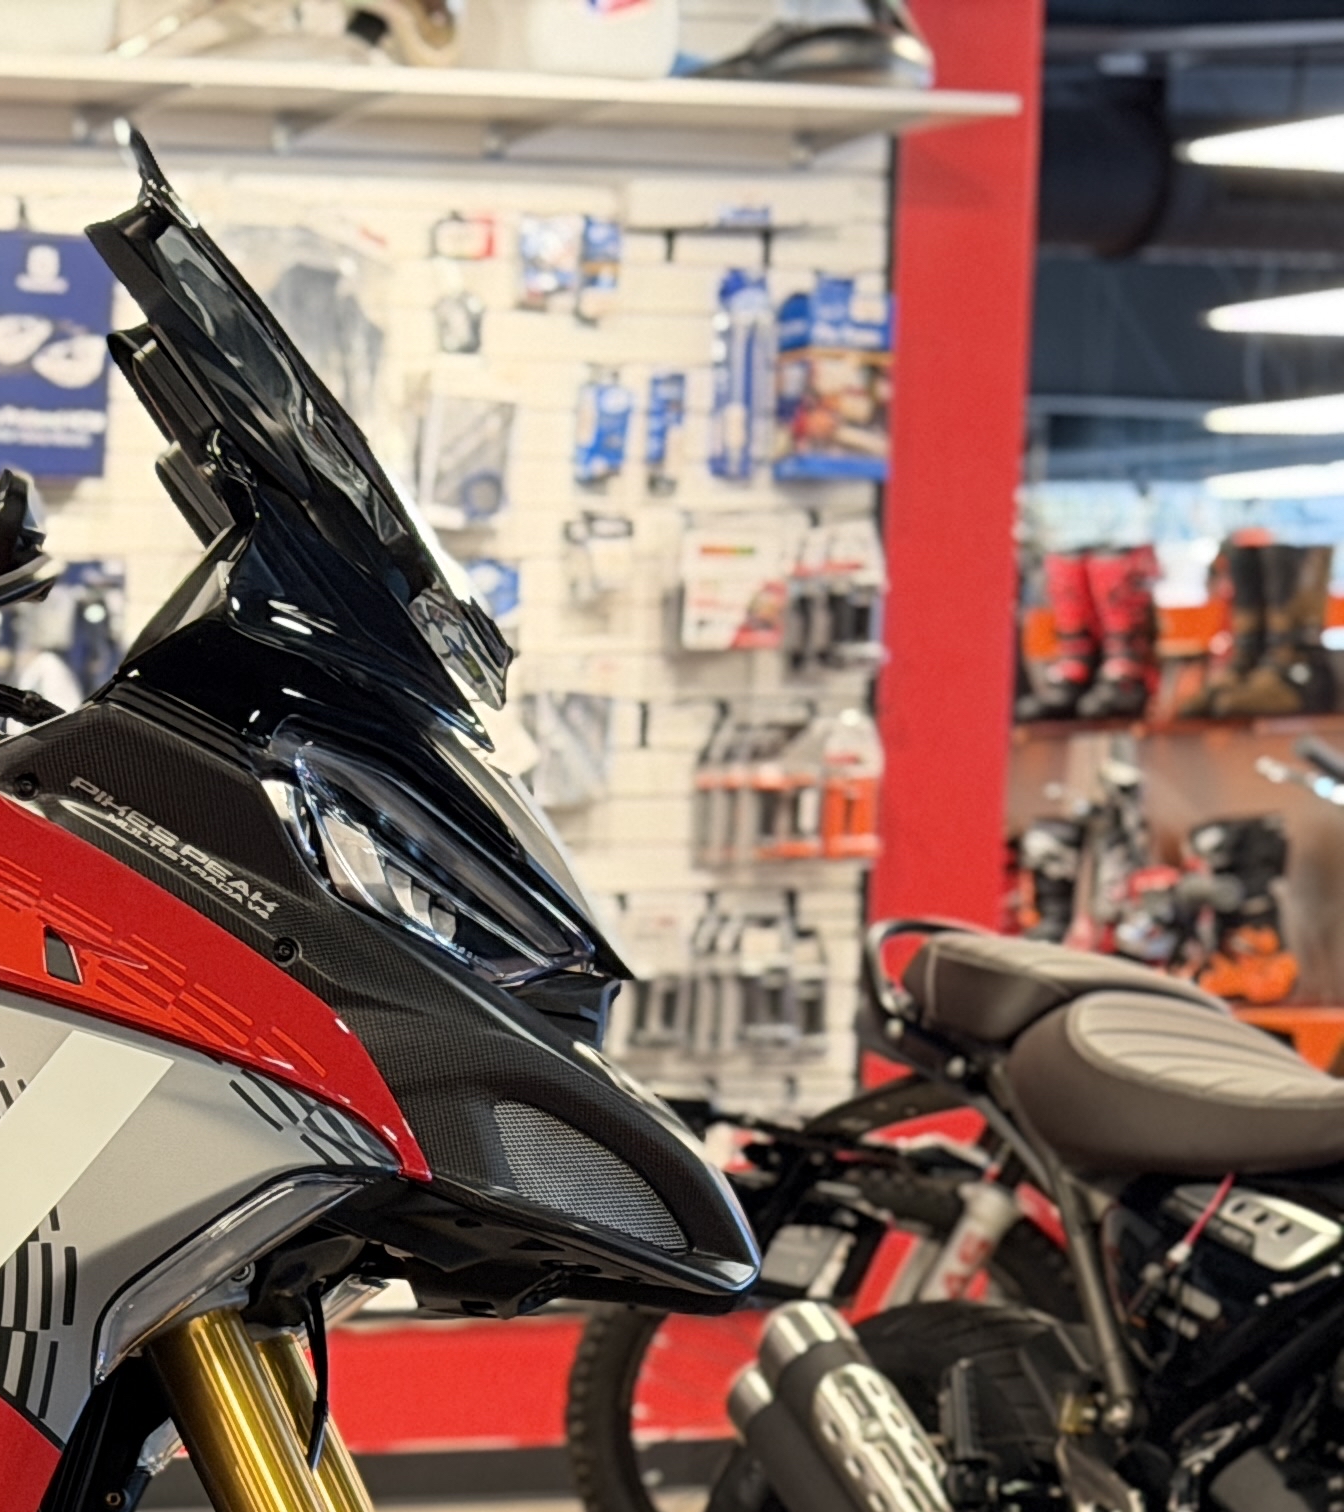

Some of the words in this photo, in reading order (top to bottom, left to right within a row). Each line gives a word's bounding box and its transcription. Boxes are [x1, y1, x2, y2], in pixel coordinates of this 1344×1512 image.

[69, 775, 180, 848] PIKES
[179, 844, 280, 913] PEAK
[105, 812, 244, 904] MULTISTRADA
